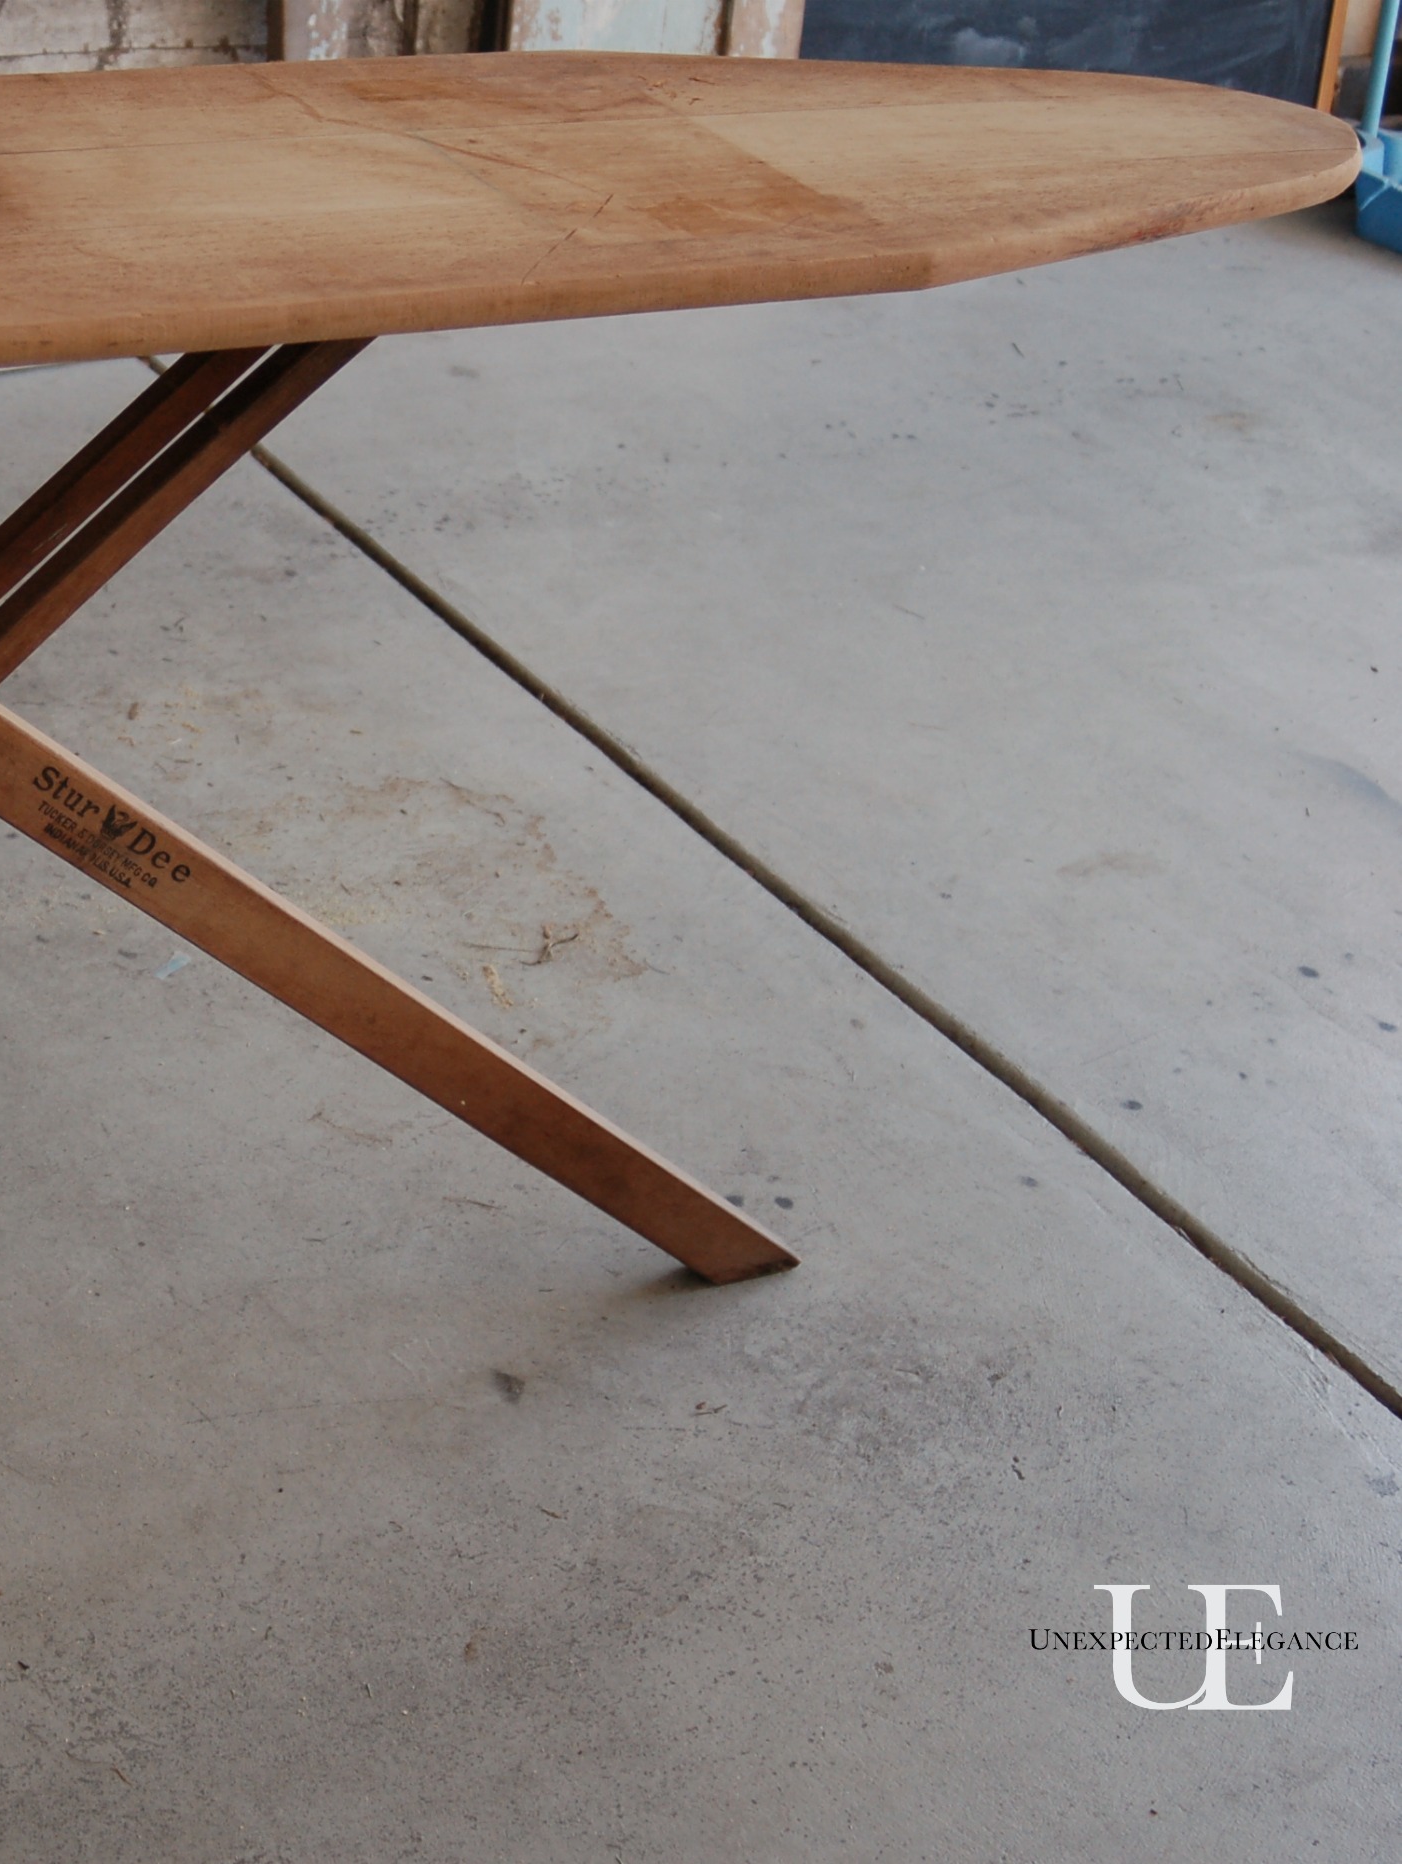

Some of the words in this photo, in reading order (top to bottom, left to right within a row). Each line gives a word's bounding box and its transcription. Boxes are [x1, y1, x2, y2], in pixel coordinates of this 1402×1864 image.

[33, 766, 100, 818] Stur
[128, 828, 191, 883] Dee
[38, 801, 77, 831] TUCKER
